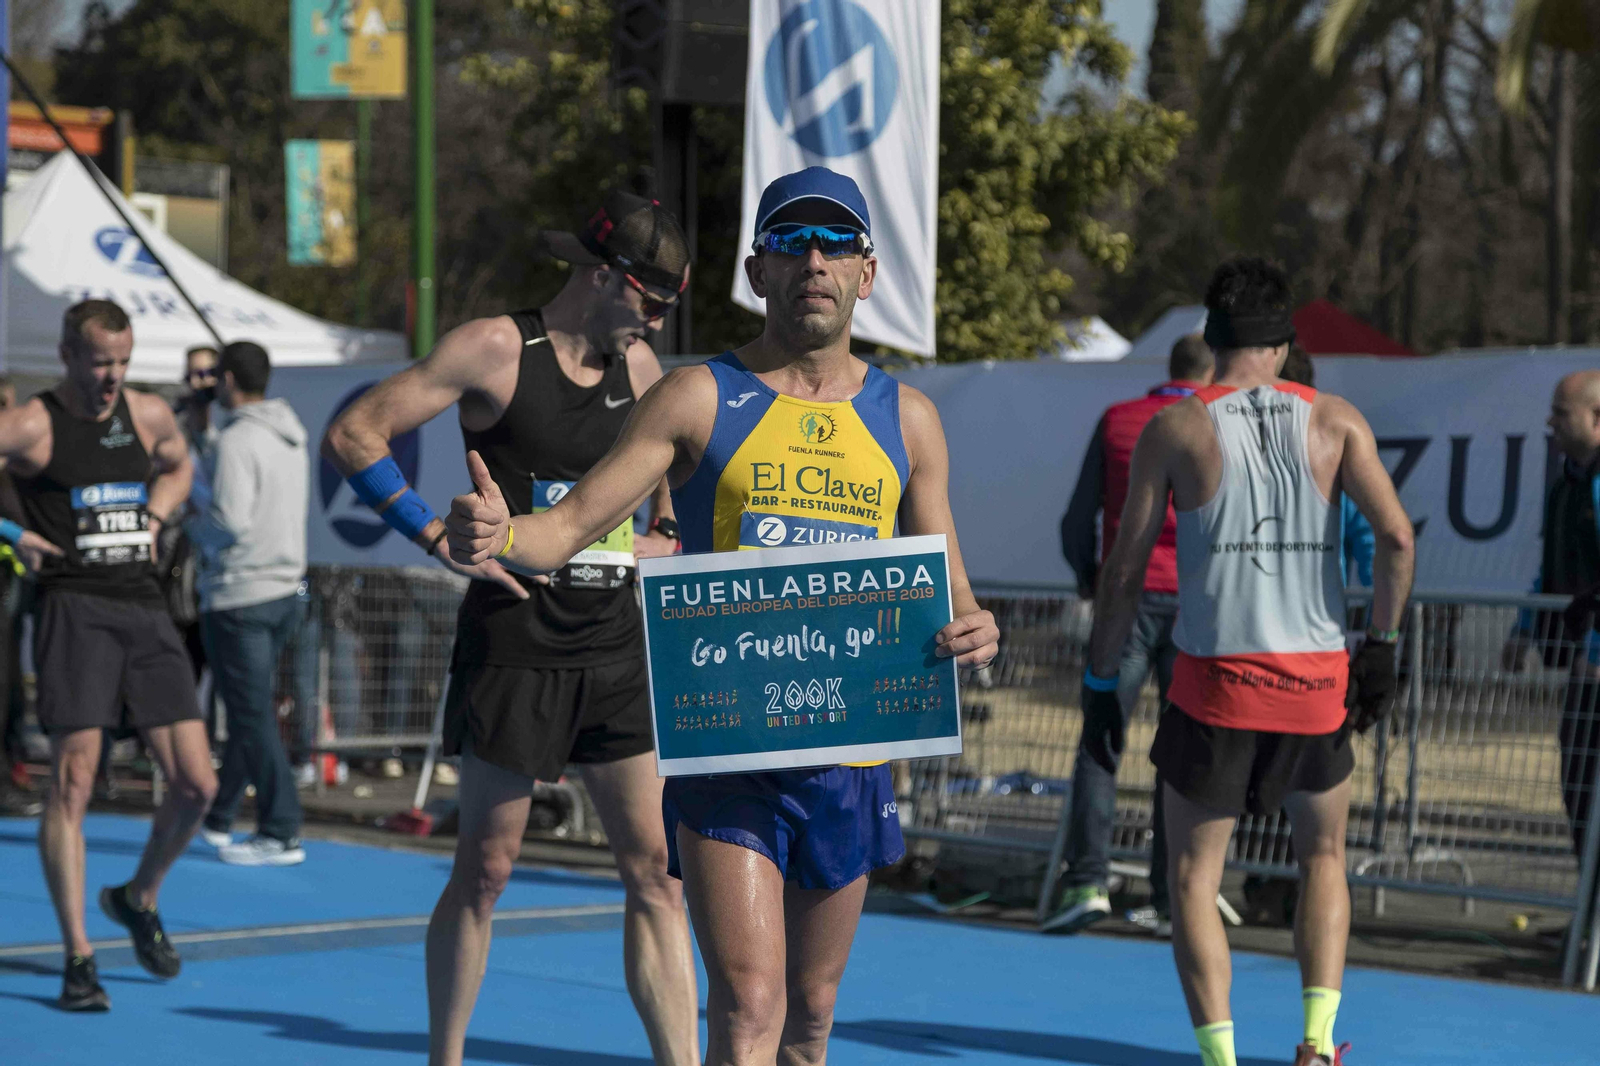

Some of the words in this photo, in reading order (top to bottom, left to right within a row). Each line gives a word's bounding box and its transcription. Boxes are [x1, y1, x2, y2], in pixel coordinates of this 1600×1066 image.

[788, 445, 813, 455] FUENLA
[815, 448, 846, 459] RUNNERS
[750, 462, 786, 492] El
[796, 466, 883, 506] Clavel
[1376, 434, 1558, 541] ZU
[751, 495, 779, 506] BAR
[790, 497, 879, 521] RESTAURANTE
[791, 526, 875, 546] ZURIC
[660, 564, 935, 608] FUENLABRADA
[661, 605, 717, 620] CIUDAD
[721, 599, 794, 616] EUROPEA
[798, 597, 825, 610] DEL
[828, 590, 897, 606] DEPORTE
[900, 587, 935, 600] 2019
[691, 637, 727, 667] Go
[735, 624, 836, 662] Fuenla,
[764, 677, 847, 714] 200K
[766, 714, 801, 728] UNITED
[802, 713, 815, 725] BY
[816, 711, 847, 724] SPORT
